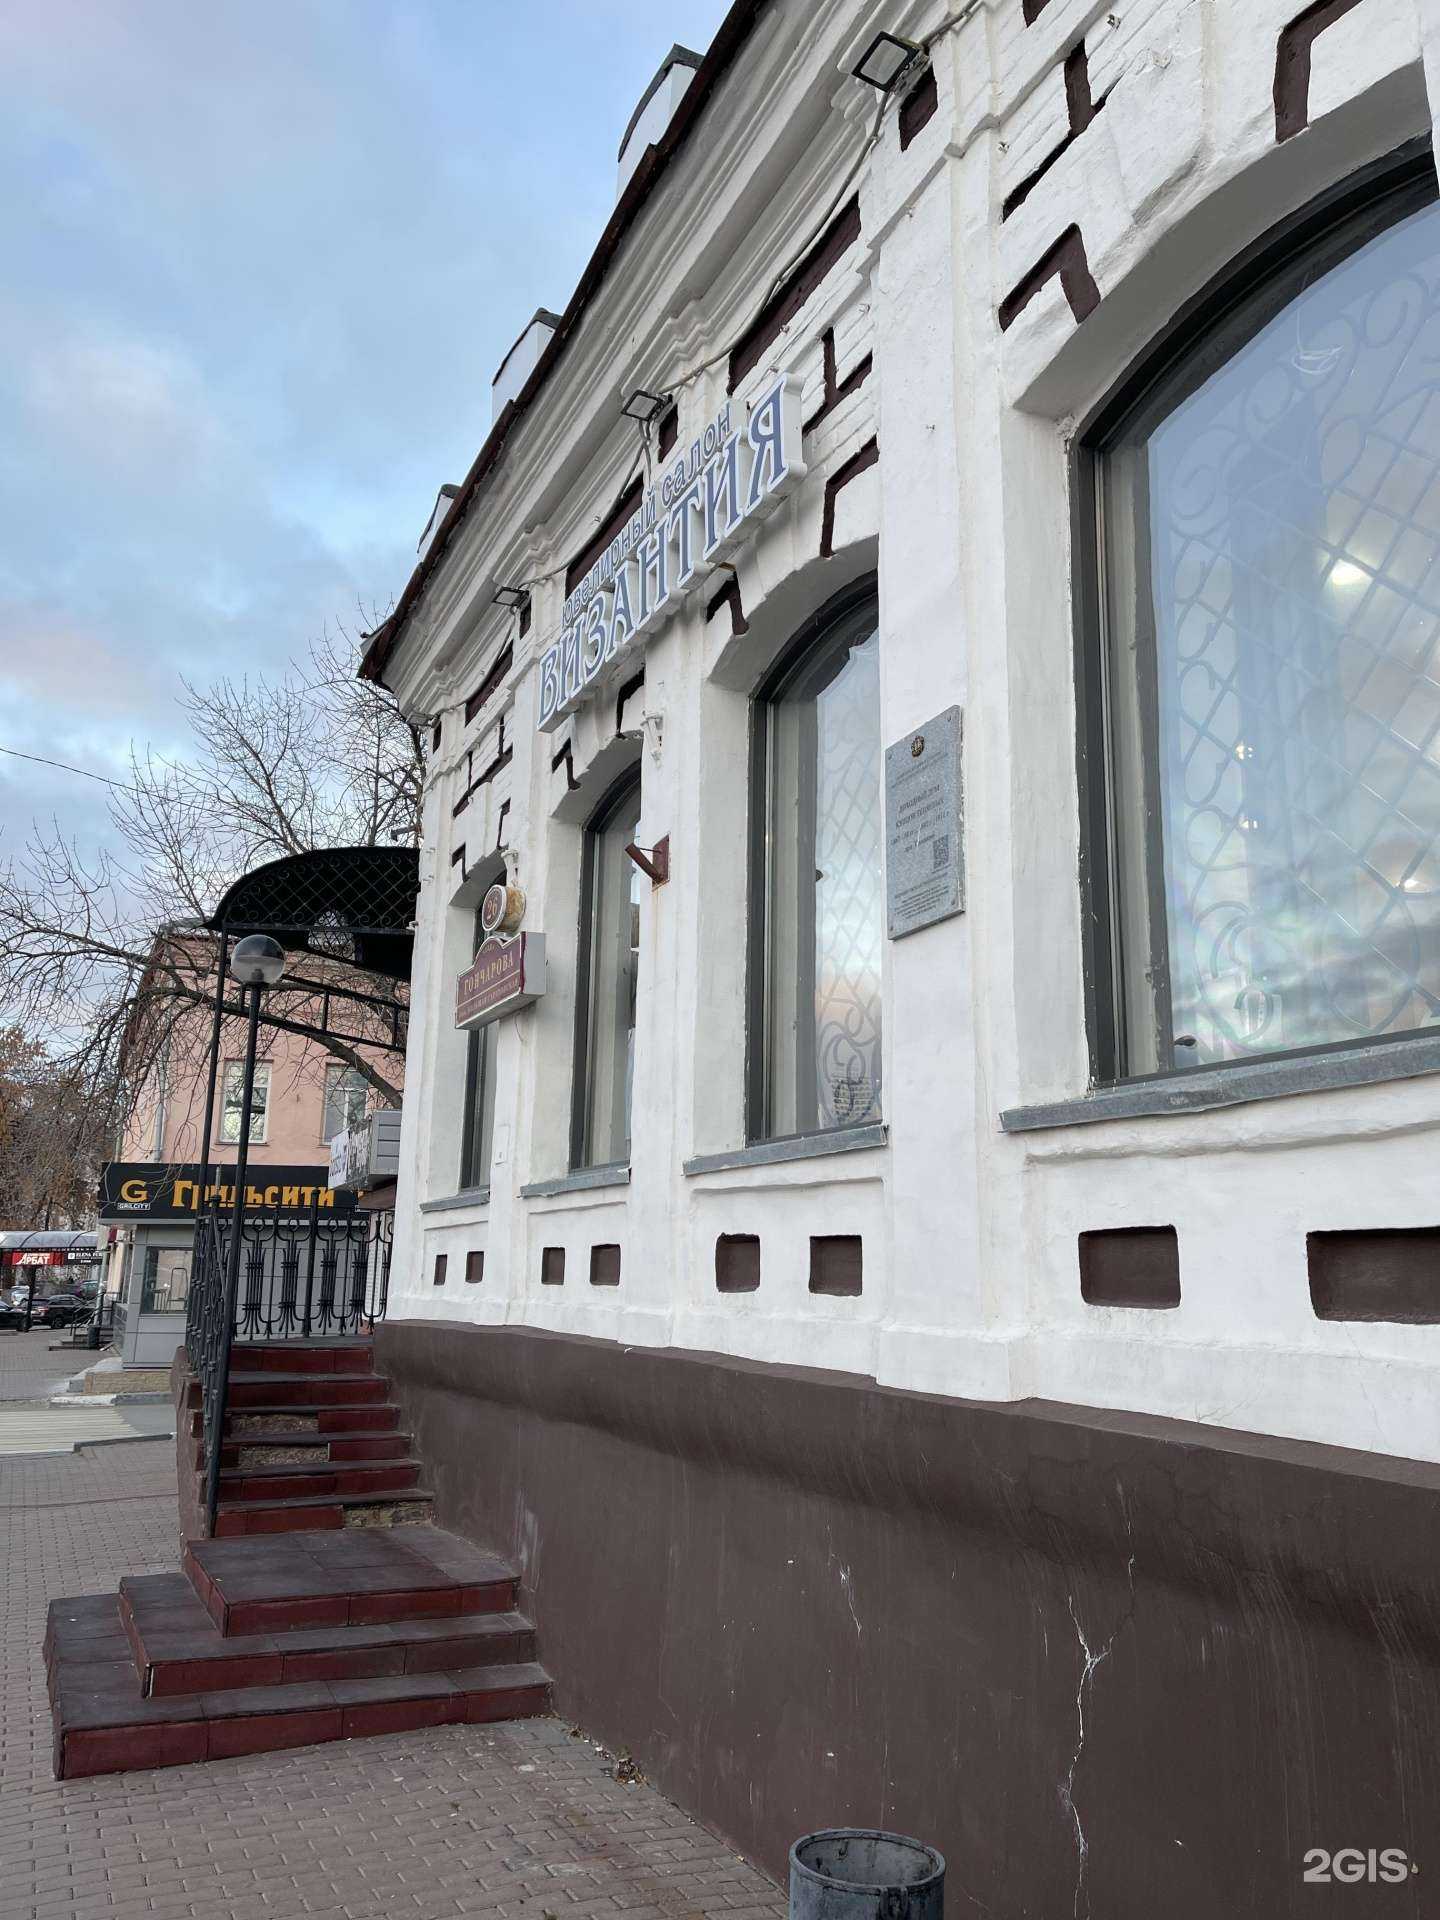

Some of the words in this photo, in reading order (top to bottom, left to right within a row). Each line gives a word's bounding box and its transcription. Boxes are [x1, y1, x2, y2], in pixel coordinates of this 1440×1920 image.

[662, 400, 731, 508] салон
[537, 377, 790, 728] ВИЗАНТИЯ
[486, 896, 498, 920] 26
[463, 951, 513, 996] ГОНЧАРОВА
